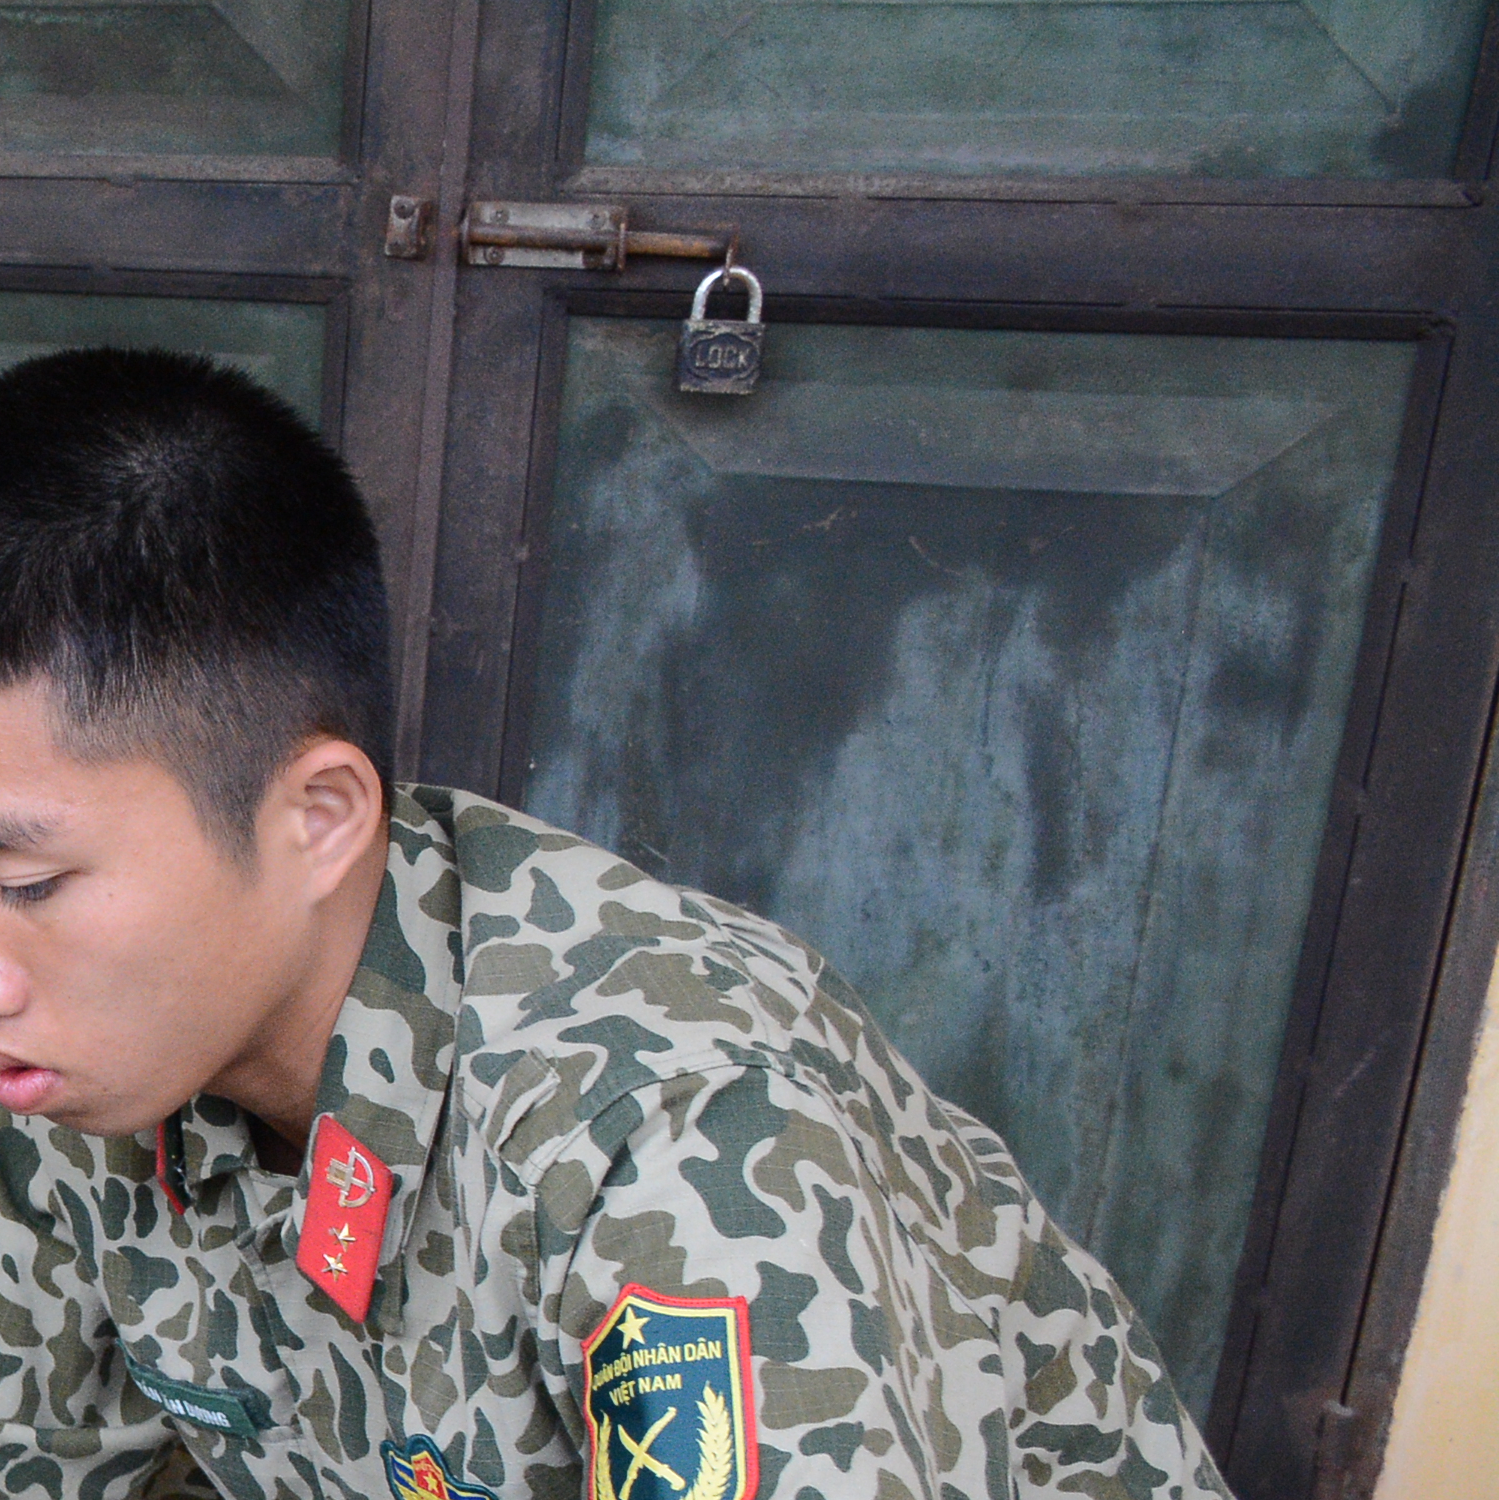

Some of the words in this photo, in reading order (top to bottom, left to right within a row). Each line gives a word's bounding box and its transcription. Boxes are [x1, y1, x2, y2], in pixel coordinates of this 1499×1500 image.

[695, 345, 750, 368] LOCK
[632, 1343, 681, 1368] NHÂN
[684, 1337, 721, 1361] DÂN
[609, 1381, 635, 1406] VIỆT
[638, 1373, 681, 1394] NAM
